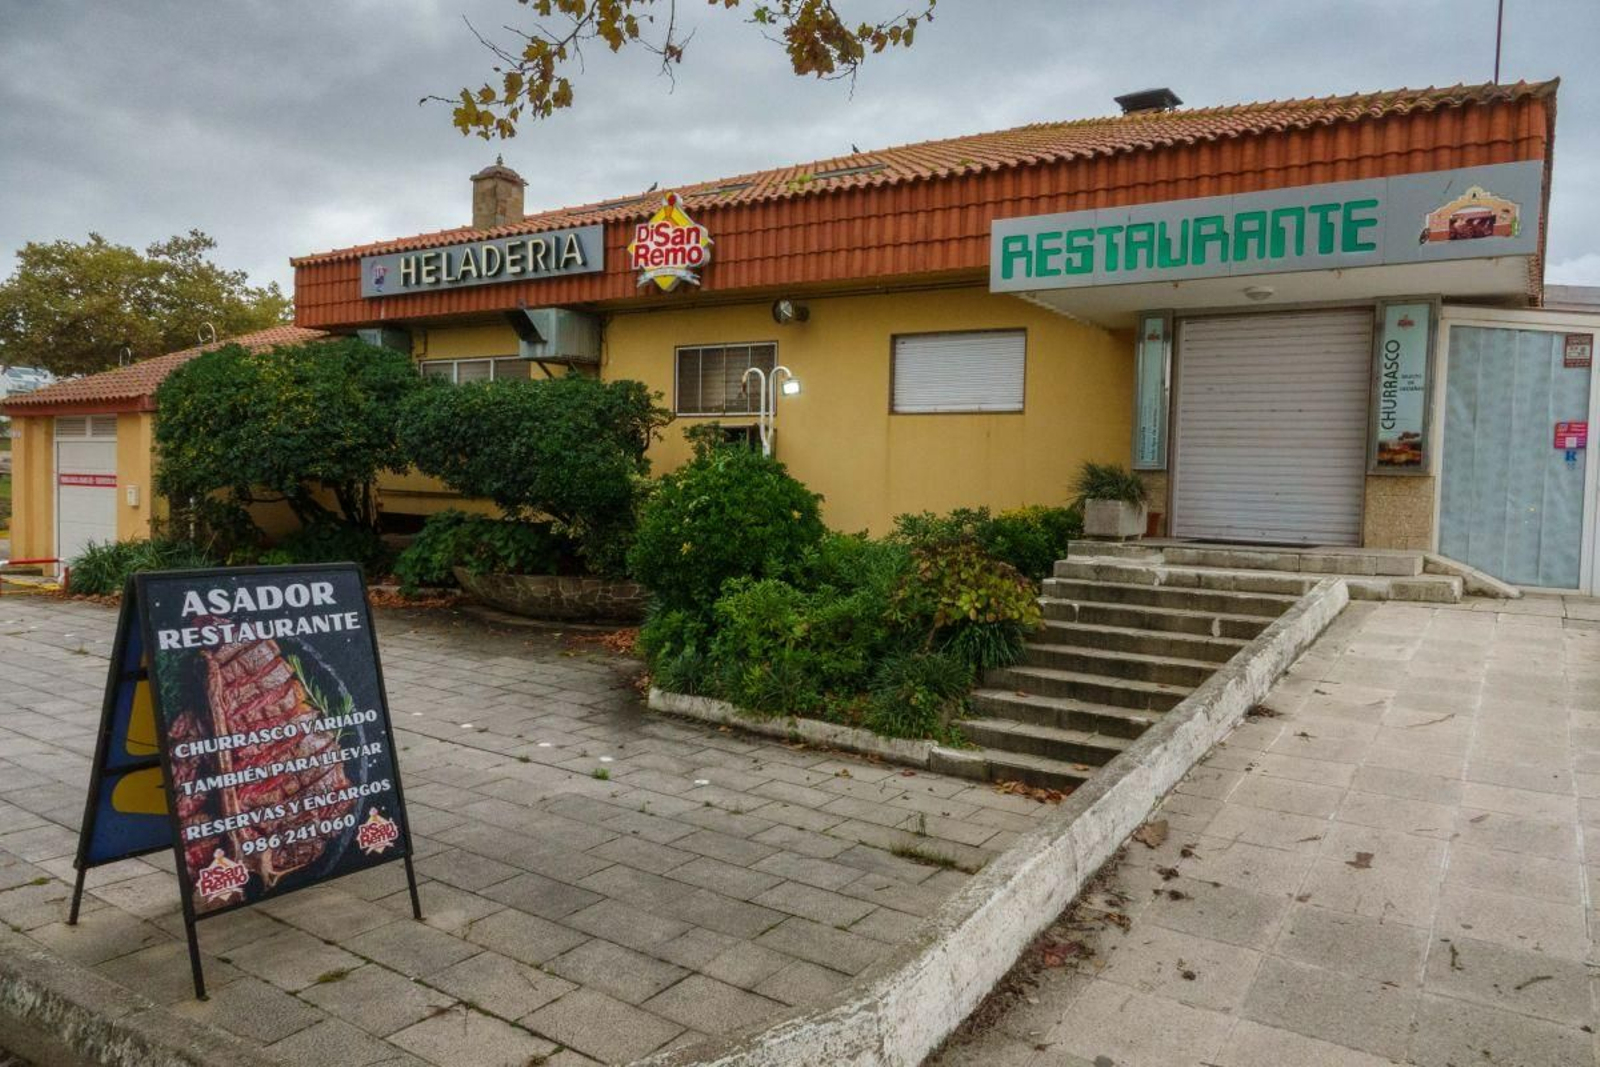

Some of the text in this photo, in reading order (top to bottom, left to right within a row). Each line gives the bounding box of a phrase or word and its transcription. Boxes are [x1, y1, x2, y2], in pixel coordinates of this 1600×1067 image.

[633, 244, 704, 268] Remo
[1001, 199, 1379, 280] RESTAURANTE
[399, 233, 584, 287] HELADERIA
[1381, 339, 1401, 430] CHURRASCO
[181, 582, 337, 617] ASADOR
[158, 611, 362, 650] RESTAURANTE
[174, 709, 378, 758] CHURRASCO VARIADO
[271, 755, 322, 779] PARA
[322, 742, 382, 765] LLEVAR
[186, 779, 392, 841] RESERVAS Y ENCARGOS
[241, 814, 356, 856] 986 241 060
[360, 830, 396, 847] Remo
[201, 874, 248, 896] Remo
